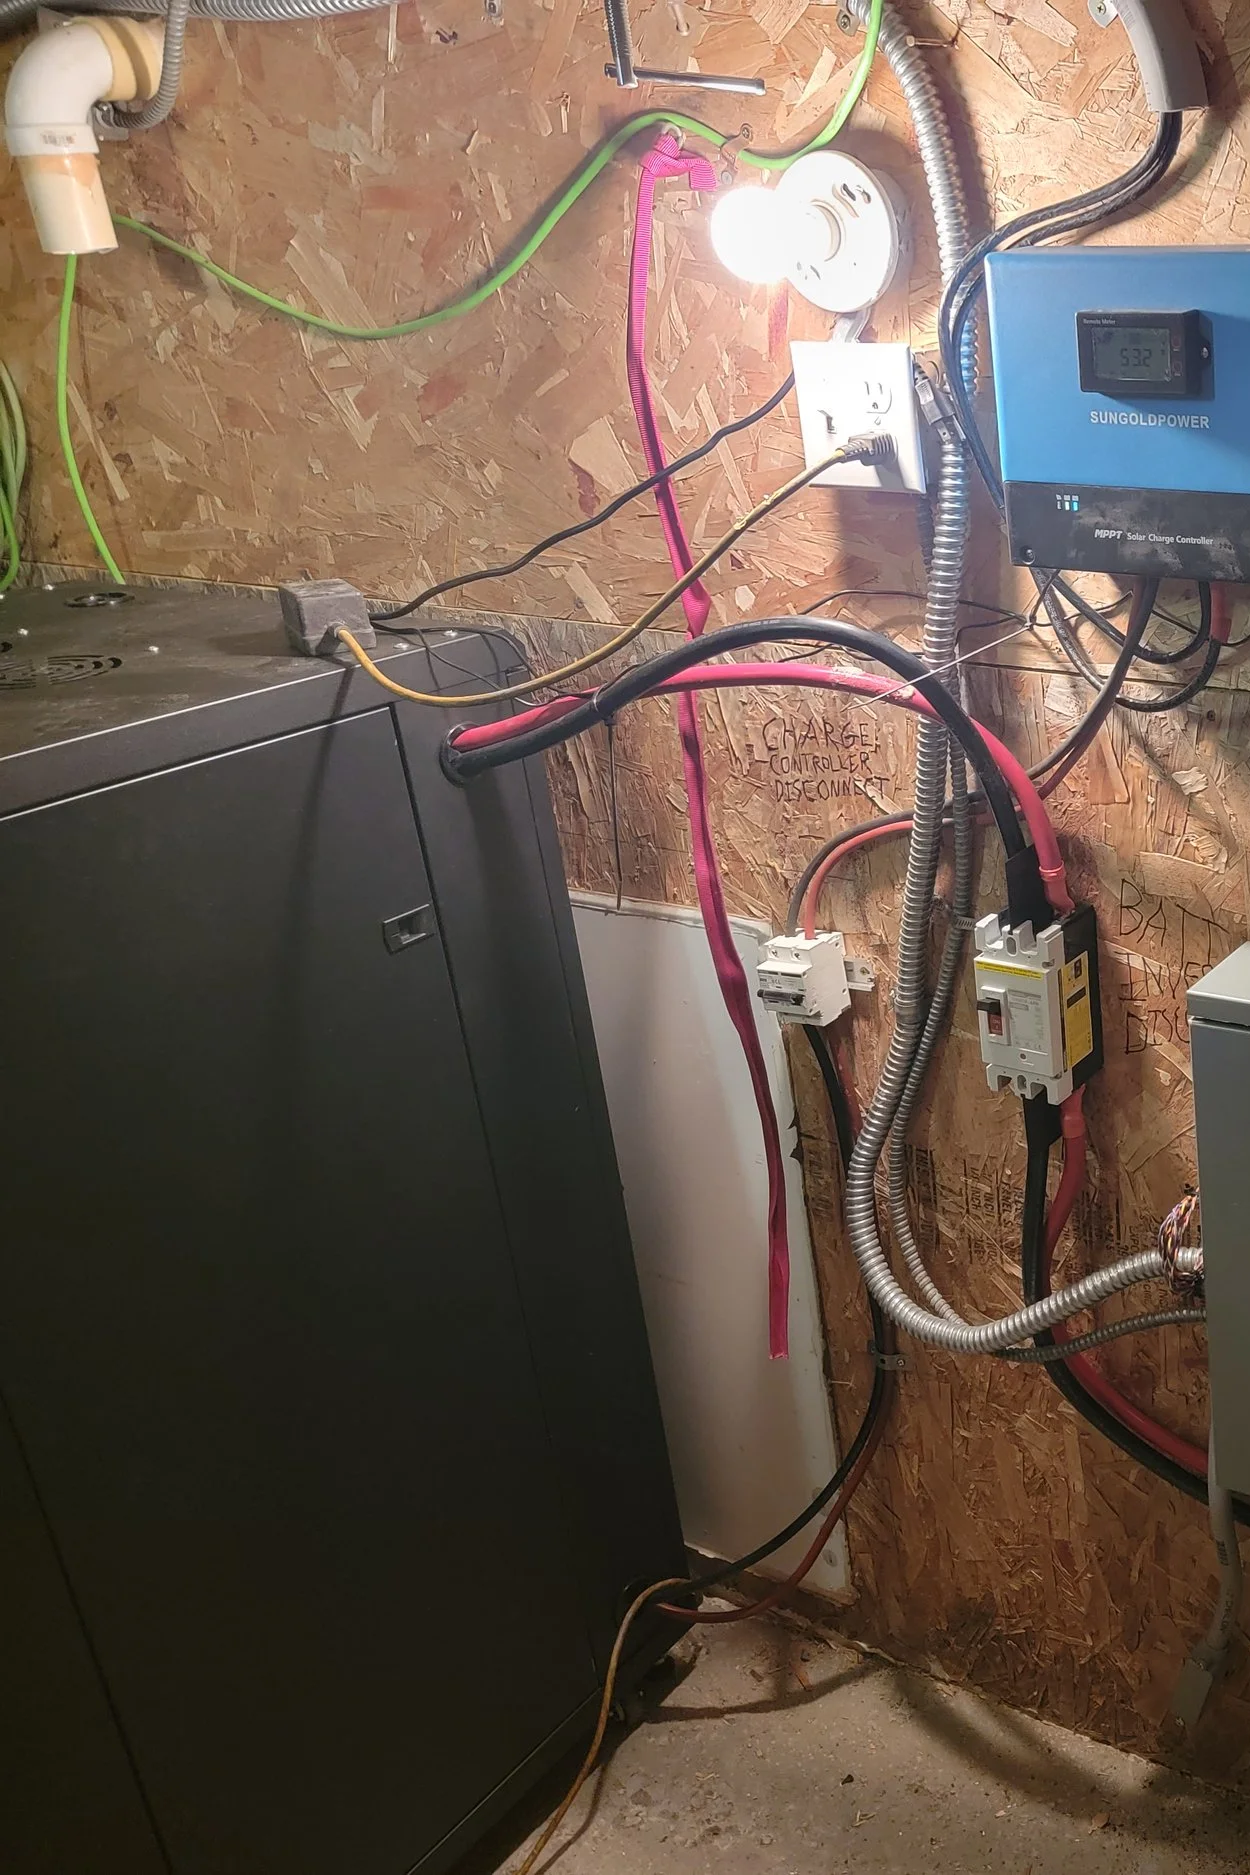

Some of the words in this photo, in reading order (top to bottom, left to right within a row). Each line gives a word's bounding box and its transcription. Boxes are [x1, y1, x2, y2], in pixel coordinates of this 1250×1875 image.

[1102, 317, 1116, 325] Meter
[1090, 411, 1210, 429] SUNGOLDPOWER
[1094, 529, 1123, 540] MPPT
[1126, 532, 1146, 541] Solar
[1148, 533, 1175, 545] Charge
[1176, 535, 1214, 545] Controller
[762, 716, 873, 751] CHARGE
[769, 751, 873, 775] CONTROLLER
[774, 776, 891, 803] DISCONNECT
